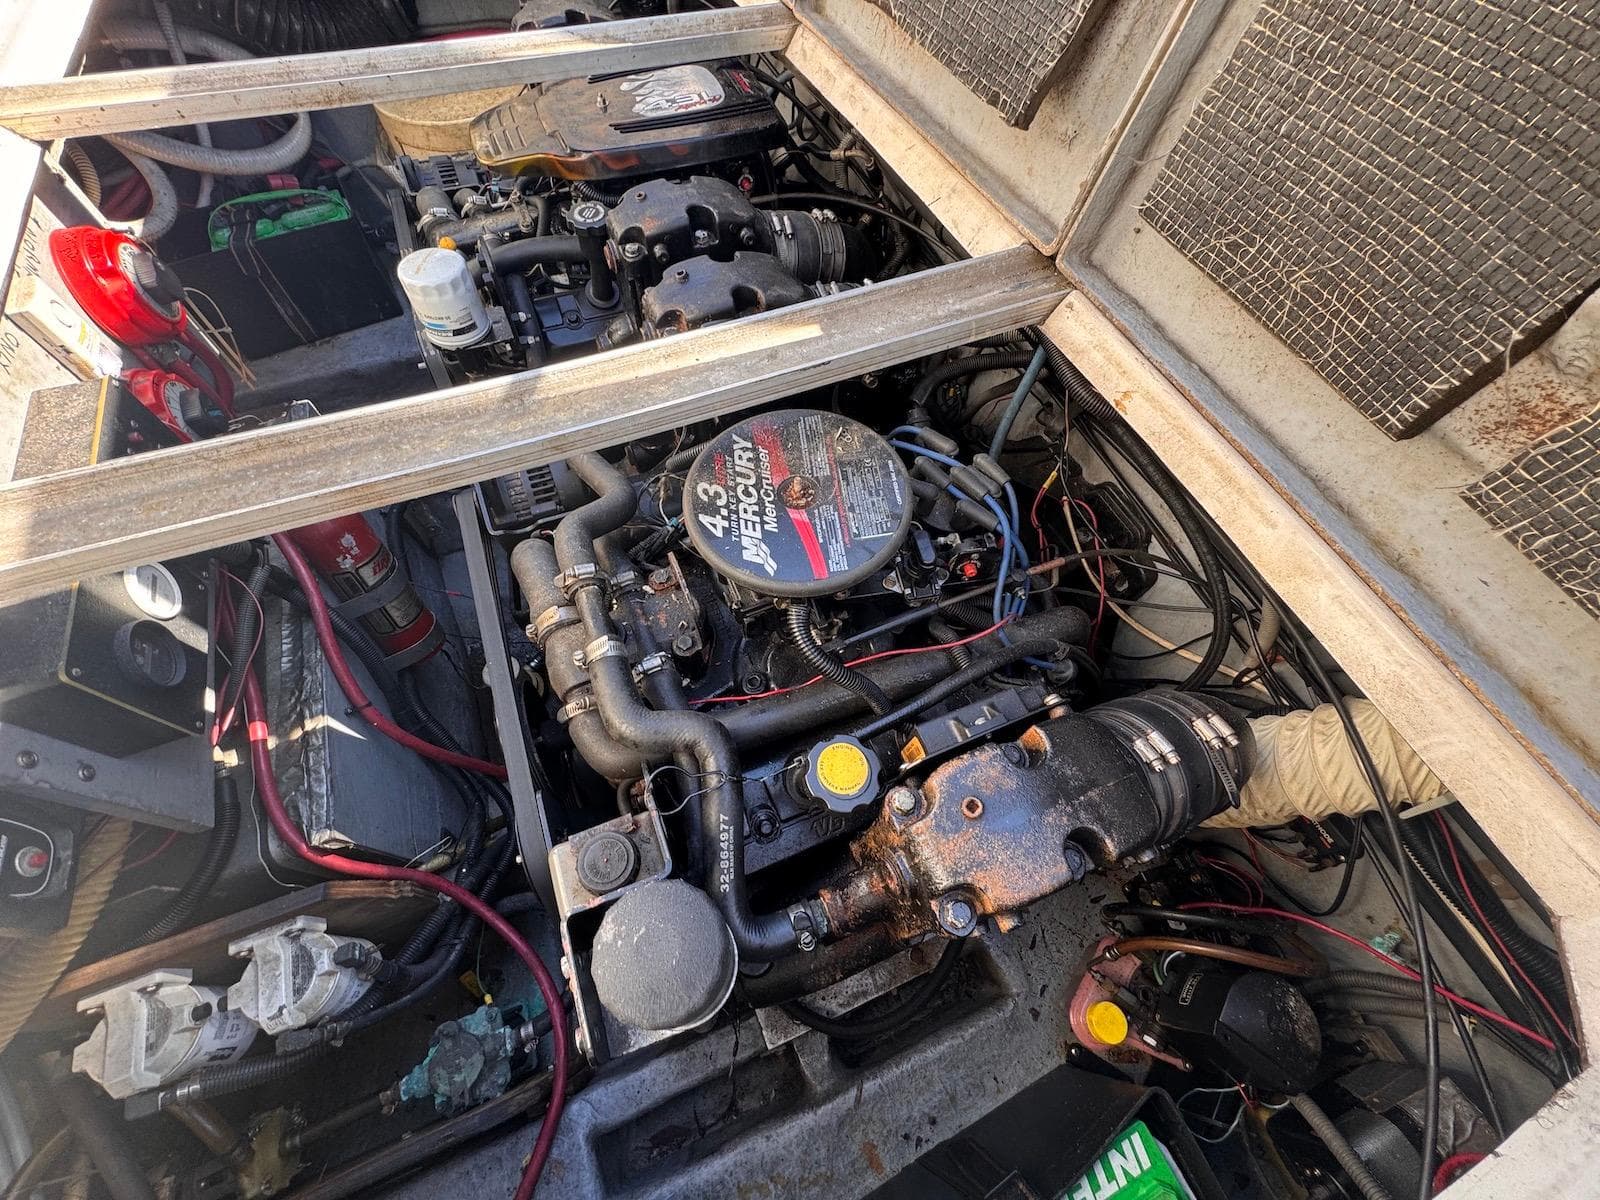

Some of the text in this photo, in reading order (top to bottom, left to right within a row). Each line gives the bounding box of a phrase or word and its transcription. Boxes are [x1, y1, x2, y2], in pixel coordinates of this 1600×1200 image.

[697, 481, 728, 537] 4.3
[726, 455, 739, 540] TURN KEY START
[732, 432, 763, 563] MERCURY
[756, 445, 778, 532] MerCruiser
[720, 813, 729, 892] 32-864977
[1069, 1131, 1151, 1199] INTE
